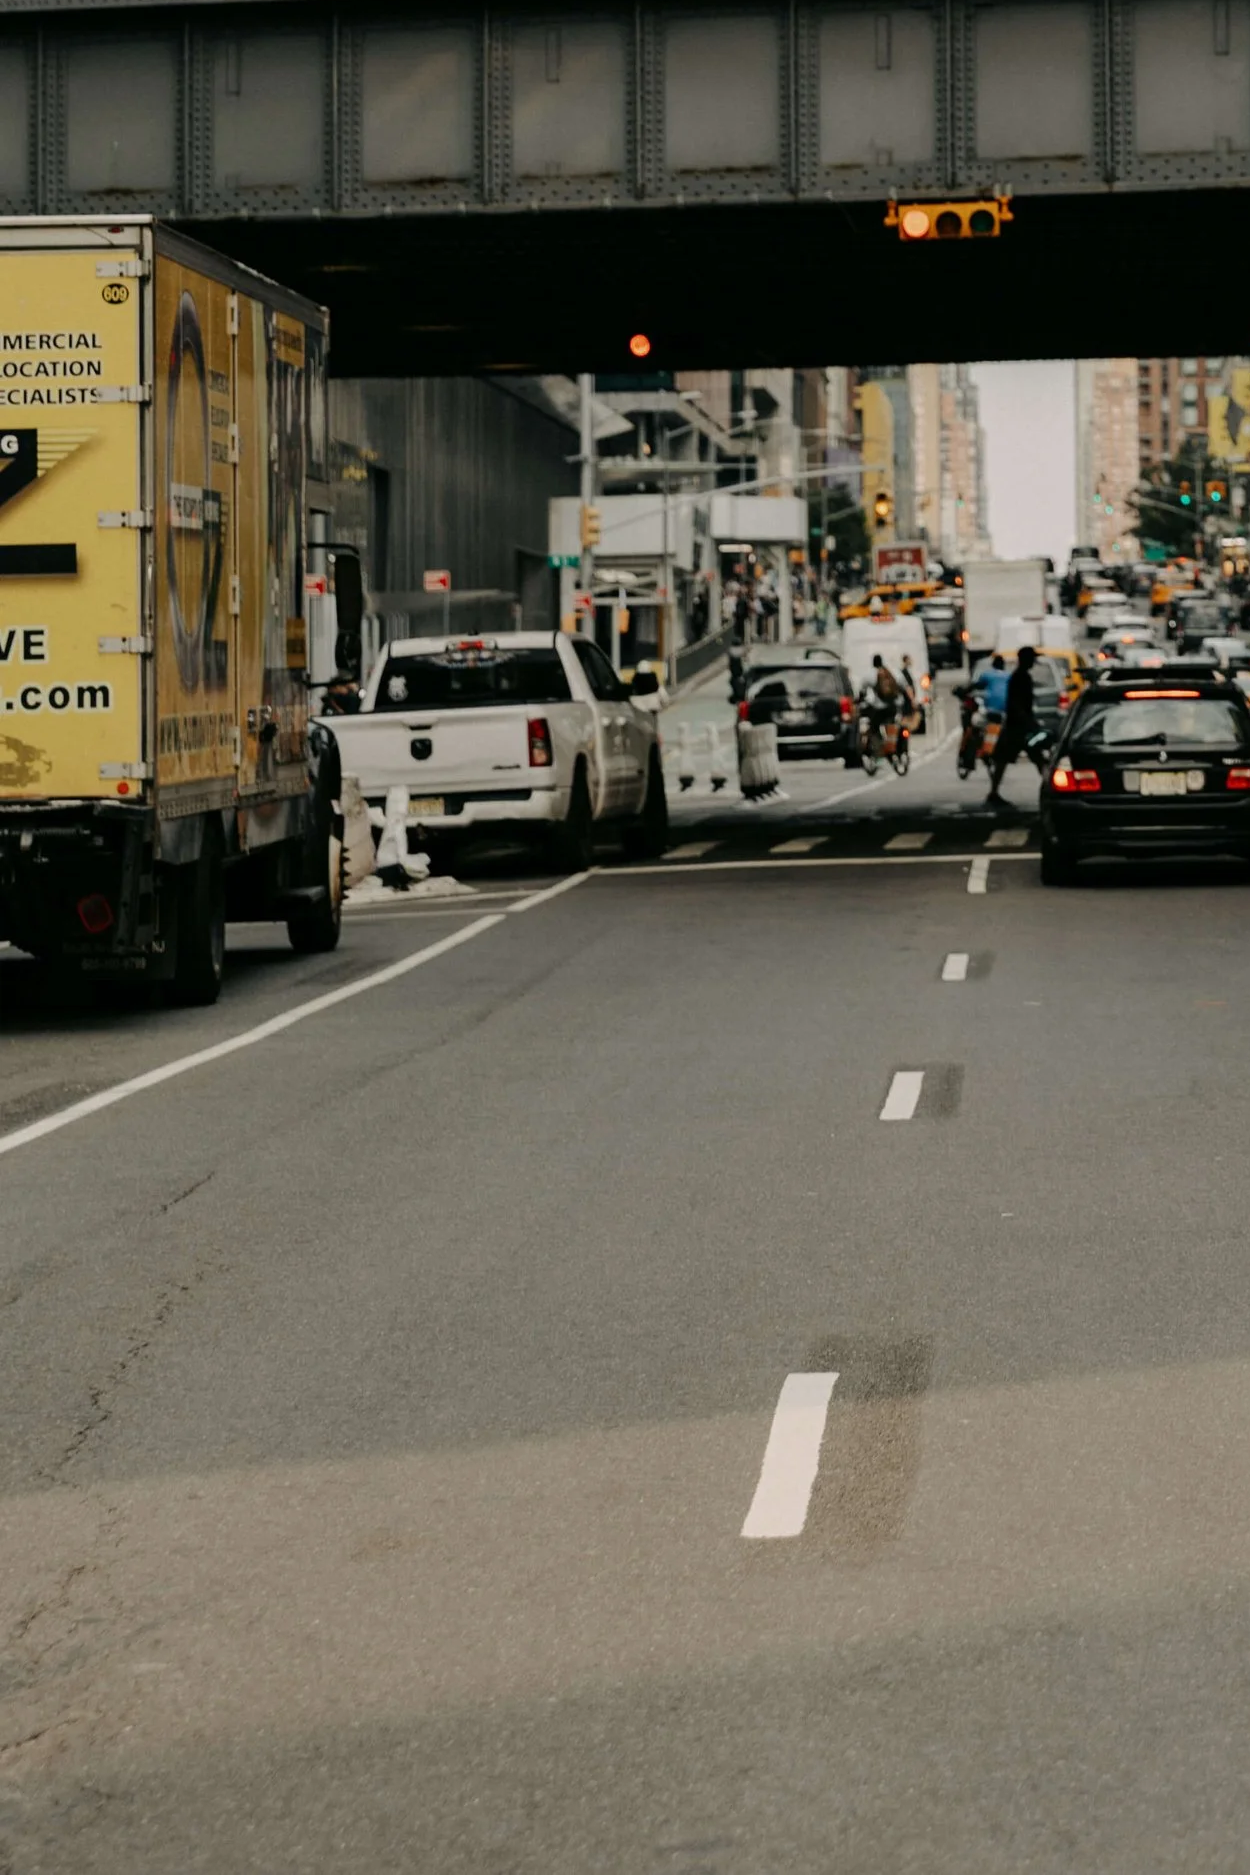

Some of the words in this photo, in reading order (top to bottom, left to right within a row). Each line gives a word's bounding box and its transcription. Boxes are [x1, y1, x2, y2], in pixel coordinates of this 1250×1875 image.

[103, 286, 128, 302] 609
[2, 333, 103, 350] MERCIAL
[0, 360, 102, 378] OCATION
[6, 685, 110, 710] .com
